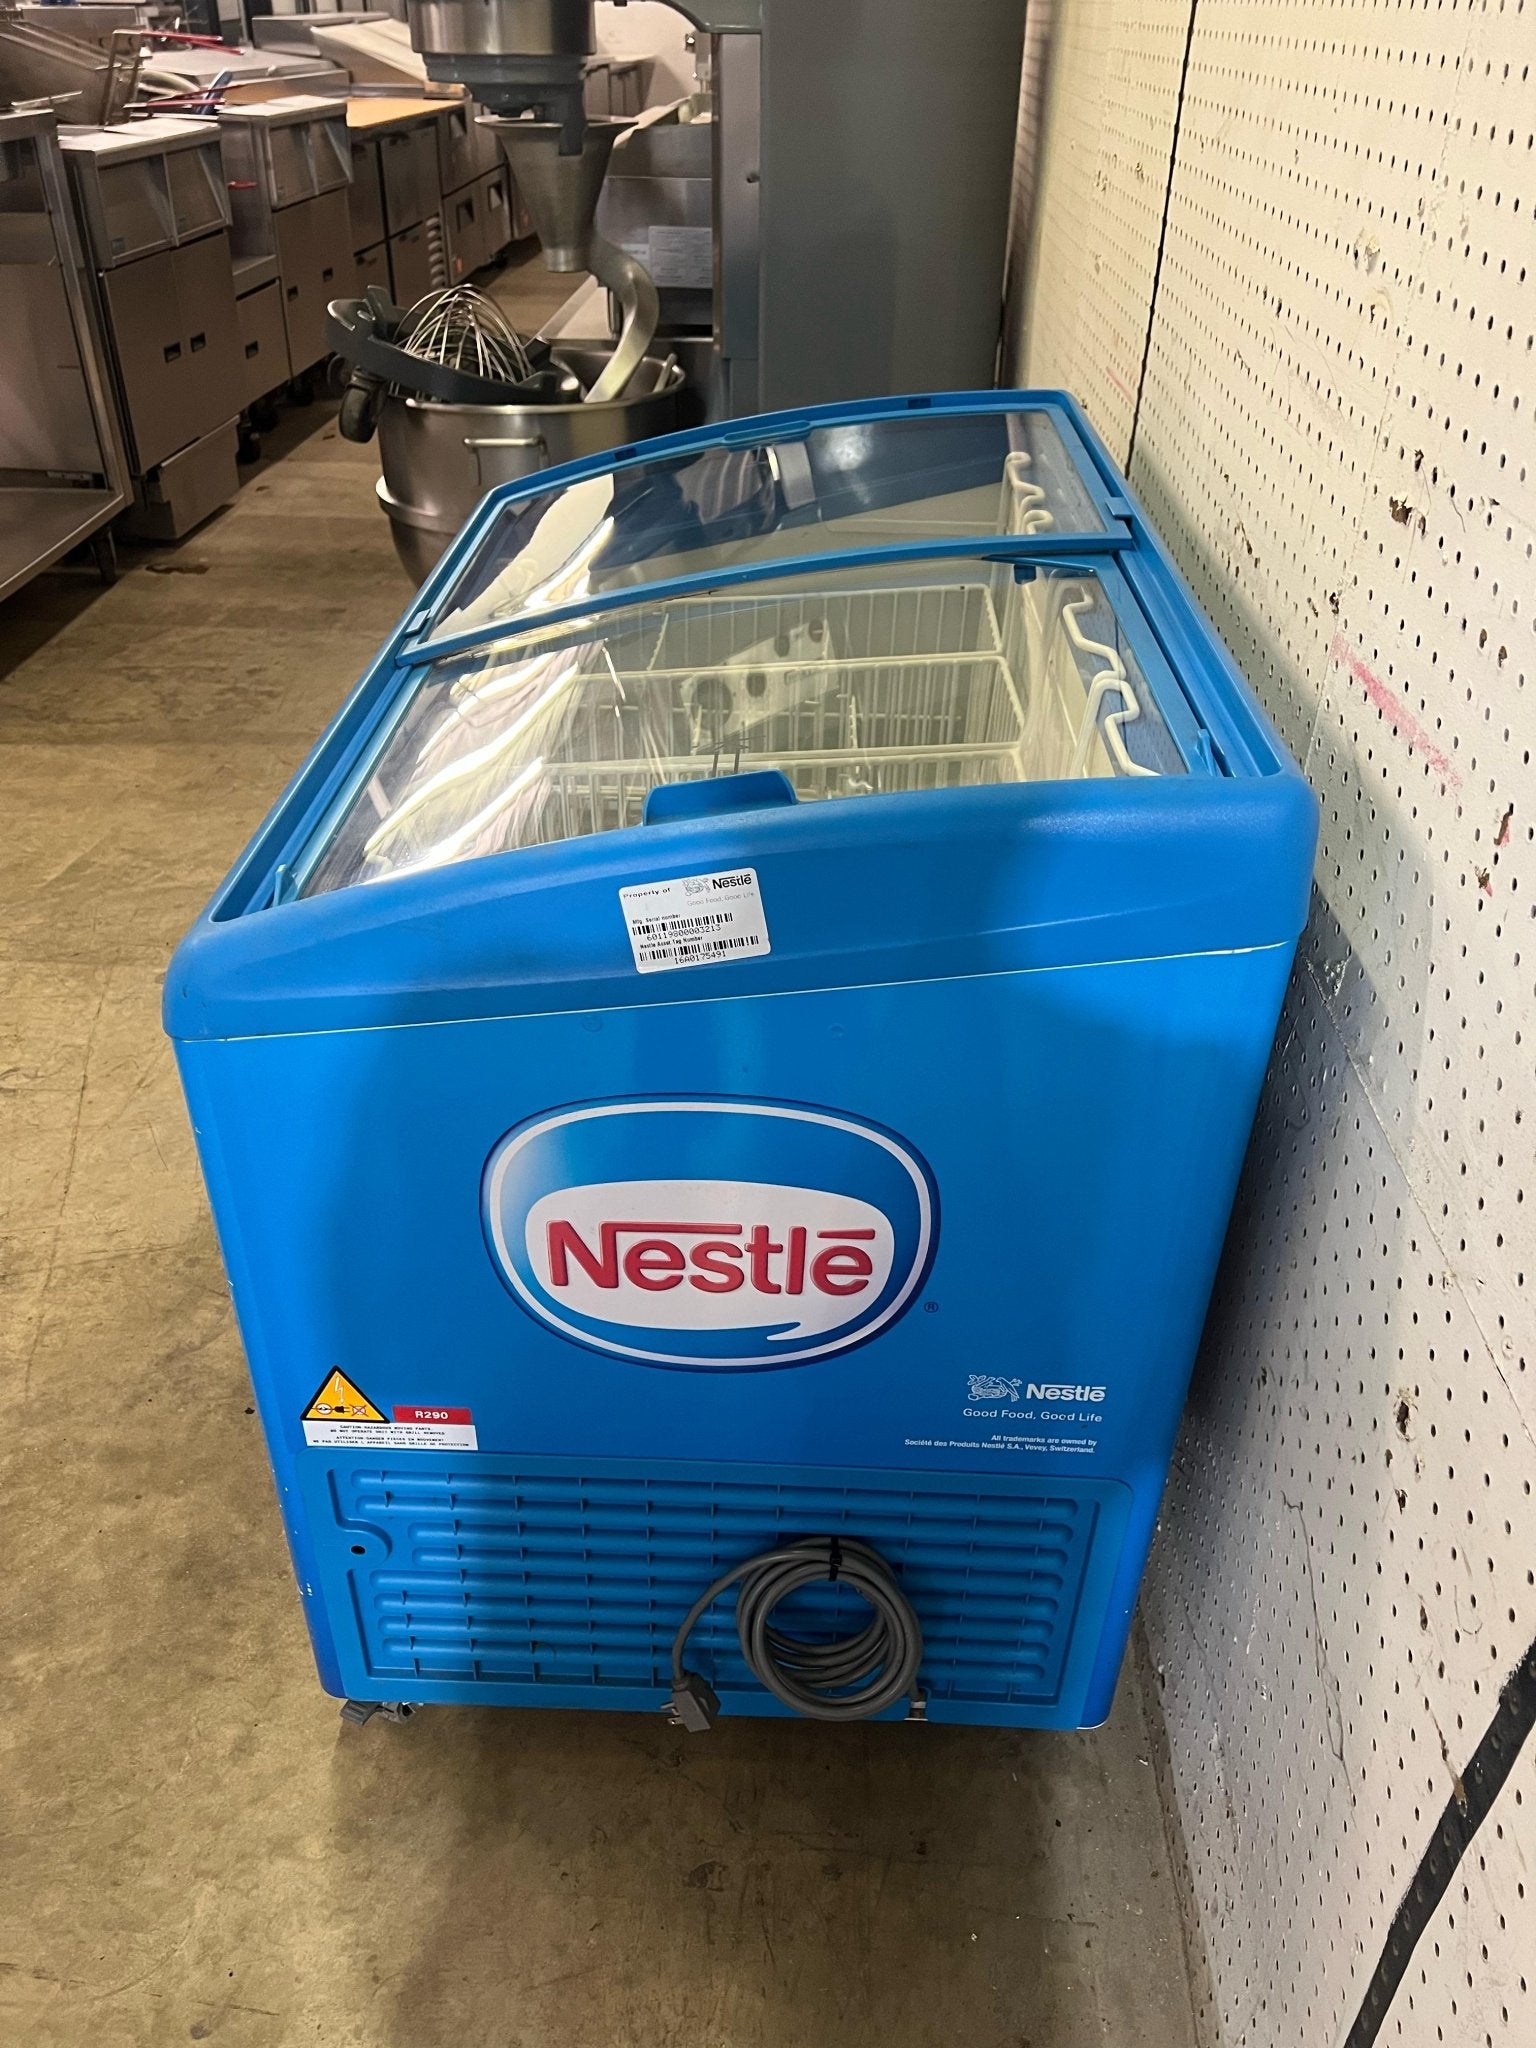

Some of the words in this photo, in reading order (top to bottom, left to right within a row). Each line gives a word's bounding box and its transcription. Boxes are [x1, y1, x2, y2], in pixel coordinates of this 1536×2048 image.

[623, 889, 659, 898] Property
[672, 938, 682, 946] Tag
[683, 936, 703, 944] Number
[675, 951, 726, 965] 16A0175491
[546, 1219, 876, 1297] Nestlé
[1027, 1384, 1106, 1402] Nestlé
[415, 1410, 449, 1419] R290
[963, 1408, 997, 1418] Good
[1002, 1409, 1036, 1420] Food,
[1041, 1411, 1075, 1421] Good
[1079, 1413, 1102, 1422] Life
[950, 1441, 979, 1449] Produits
[982, 1442, 1004, 1450] Nestlé
[1025, 1444, 1048, 1452] Vevey,
[1049, 1445, 1095, 1453] Switzerland.
[1003, 1435, 1045, 1444] trademarks
[1061, 1438, 1086, 1446] owned
[1088, 1439, 1097, 1447] by
